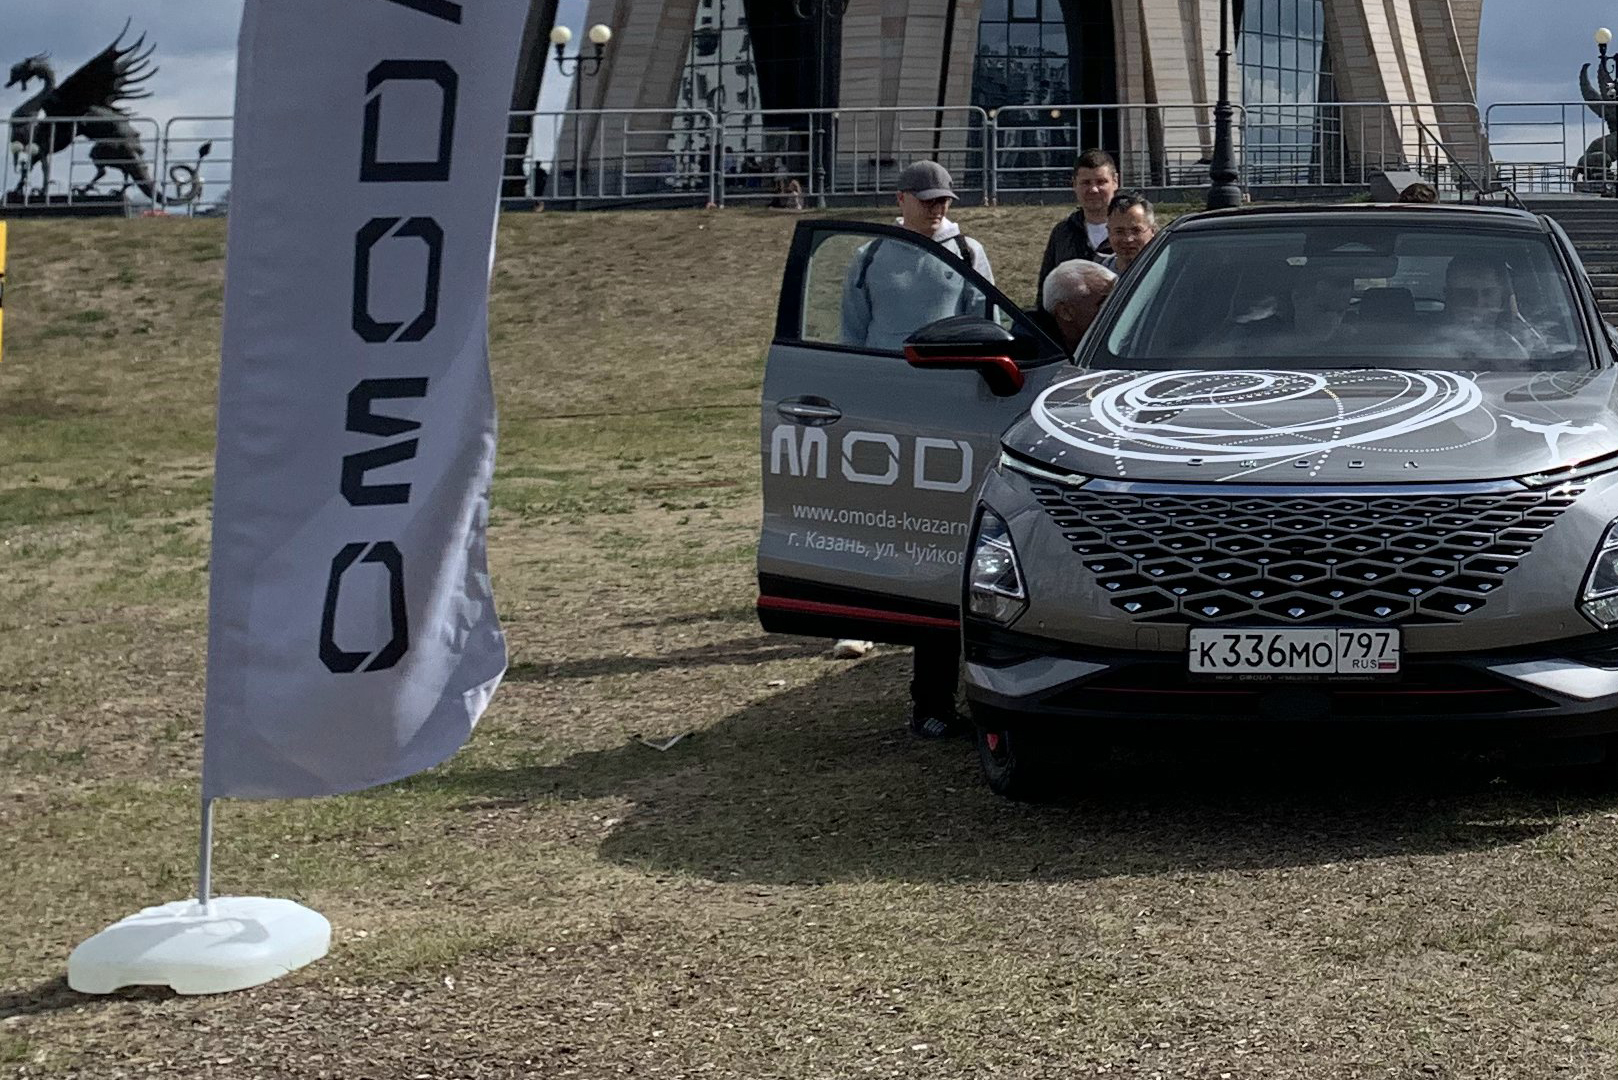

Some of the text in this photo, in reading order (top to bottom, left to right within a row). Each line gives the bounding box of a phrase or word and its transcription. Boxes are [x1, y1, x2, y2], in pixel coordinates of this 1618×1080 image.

[805, 531, 870, 558] Казань,
[873, 541, 899, 561] ул.
[1339, 632, 1391, 659] 797
[1351, 659, 1377, 669] RUS
